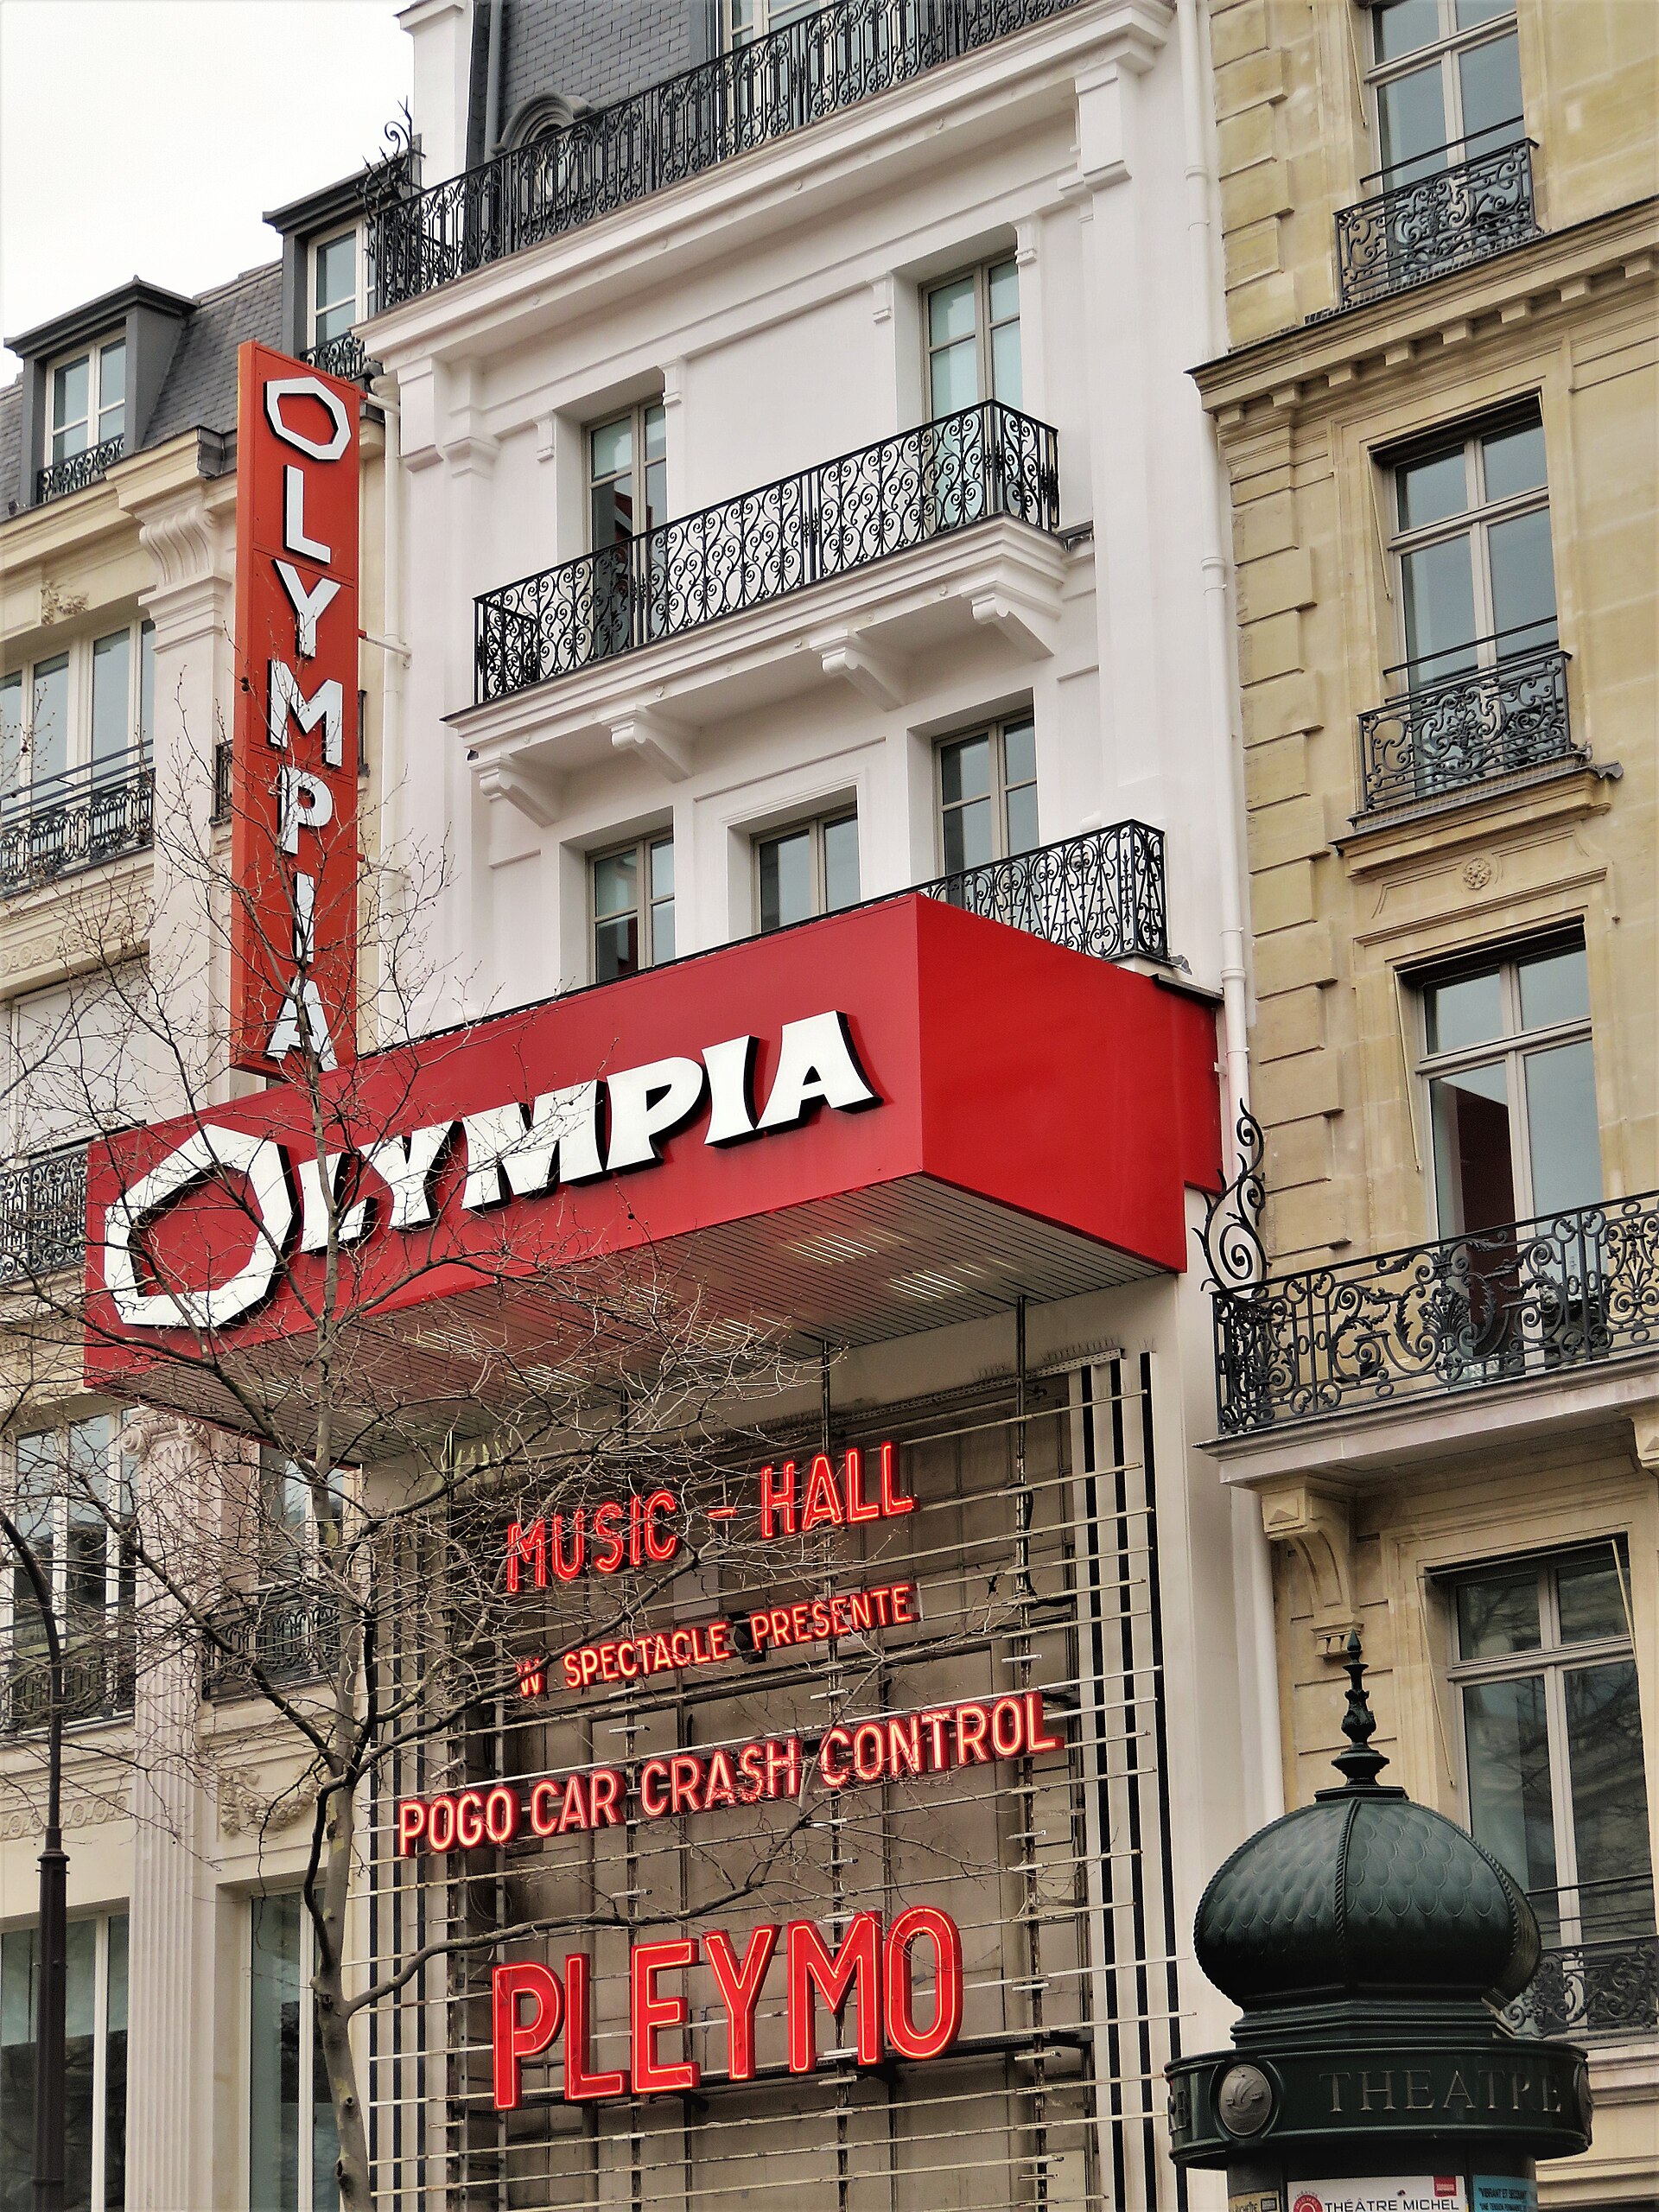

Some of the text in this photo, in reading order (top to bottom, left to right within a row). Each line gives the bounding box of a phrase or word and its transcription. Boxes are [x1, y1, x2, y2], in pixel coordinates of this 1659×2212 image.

[264, 376, 353, 1072] OLYMPIA
[104, 1010, 882, 1328] OLYMPIA
[506, 1490, 682, 1592] MUSIC
[761, 1440, 919, 1539] HALL
[563, 1621, 734, 1689] SPECTACLE
[750, 1583, 918, 1649] PRESENTE
[398, 1692, 1063, 1857] POGO CAR CRASH CONTROL
[493, 1906, 963, 2110] PLEYMO
[1319, 2069, 1561, 2113] THEATRE
[1325, 2199, 1459, 2212] THÉÂTRE MICHEL
